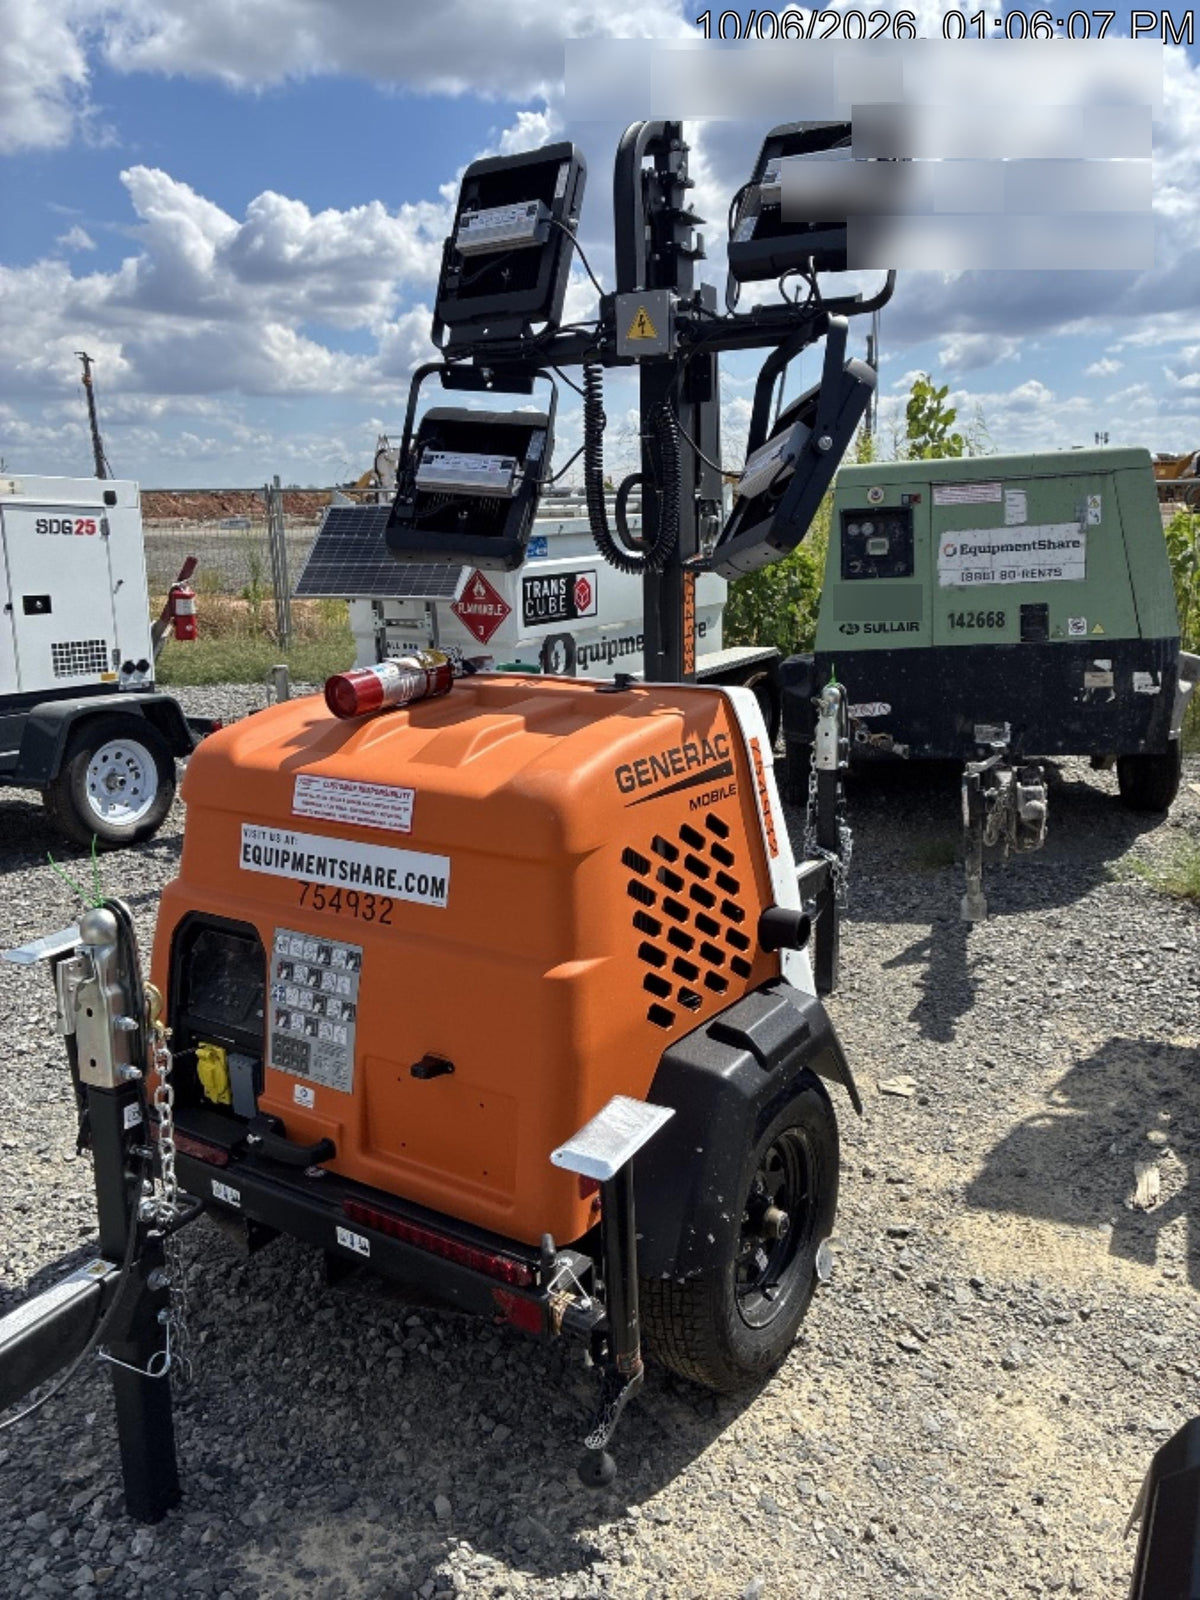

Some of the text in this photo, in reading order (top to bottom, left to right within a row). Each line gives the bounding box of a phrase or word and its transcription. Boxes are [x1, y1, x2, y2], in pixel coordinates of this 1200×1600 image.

[36, 518, 96, 535] SDG25
[959, 538, 1081, 557] EquipmentShare
[524, 577, 567, 599] TRANS
[525, 595, 567, 616] CUBE
[863, 622, 920, 634] SULLAIR
[947, 611, 1006, 629] 142668
[614, 733, 730, 794] GENERAC
[689, 783, 737, 811] MOBILE
[243, 828, 267, 840] VISIT
[269, 831, 281, 843] US
[242, 843, 446, 899] EQUIPMENTSHARE.COM
[298, 880, 394, 925] 754932
